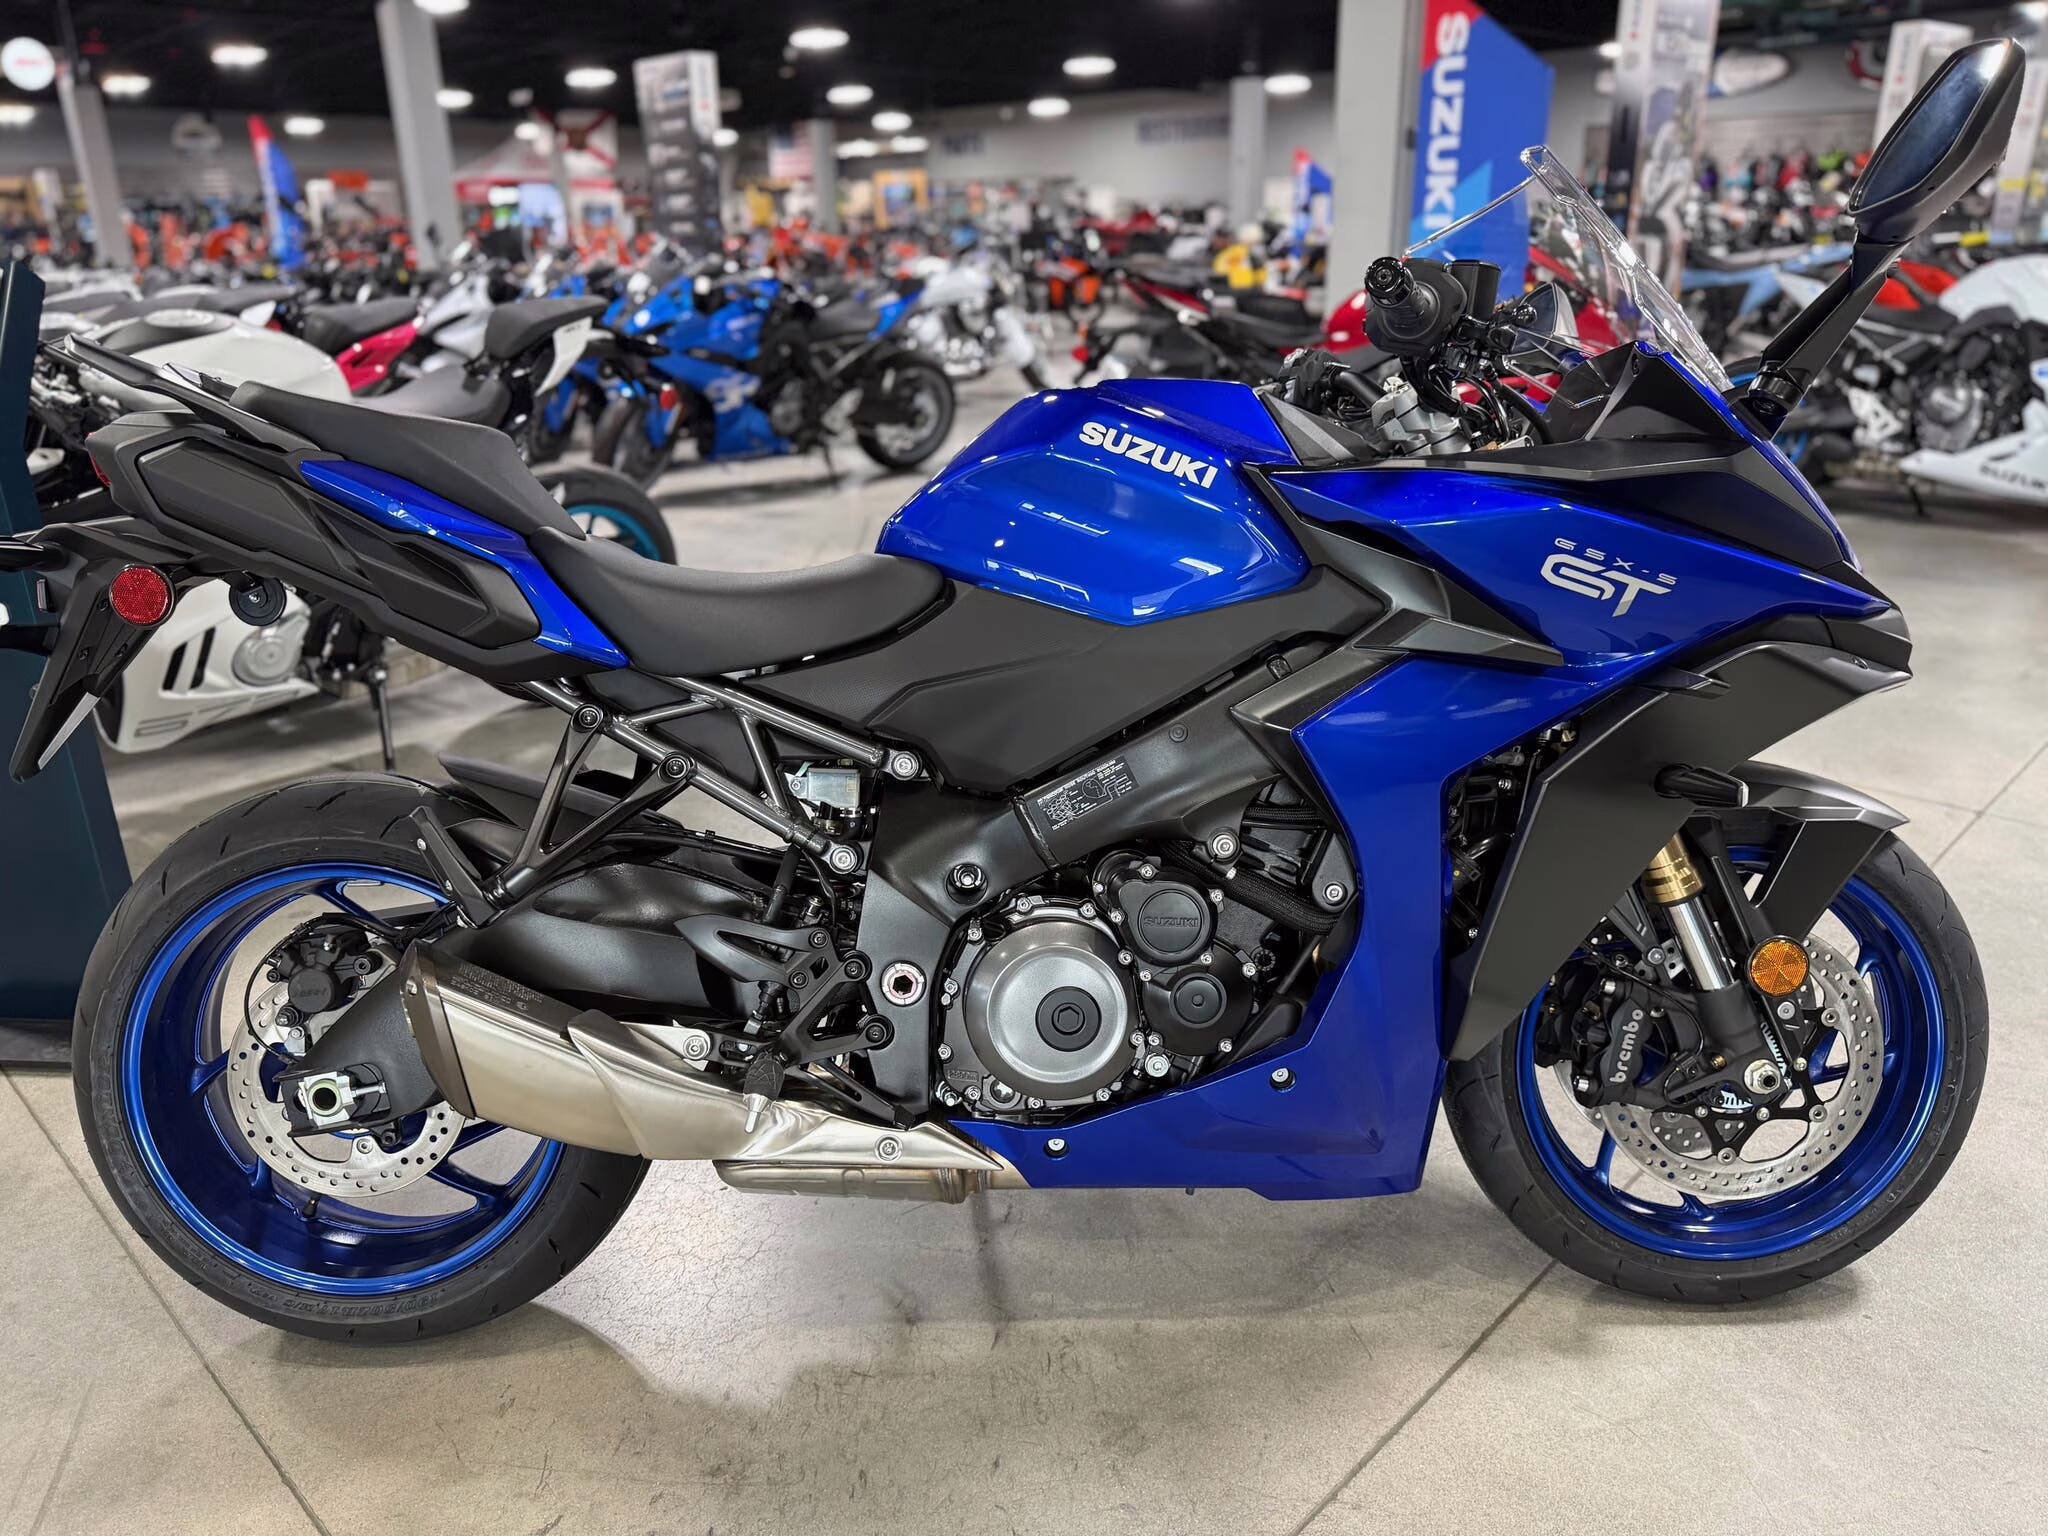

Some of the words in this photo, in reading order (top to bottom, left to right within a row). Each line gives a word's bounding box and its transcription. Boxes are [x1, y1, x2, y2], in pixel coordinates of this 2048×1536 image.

[1423, 11, 1470, 229] SUZUKI
[1079, 422, 1219, 489] SUZUKI
[1554, 537, 1678, 585] GSX-S
[1143, 916, 1199, 928] SUZUKI
[1609, 1009, 1644, 1083] brembo
